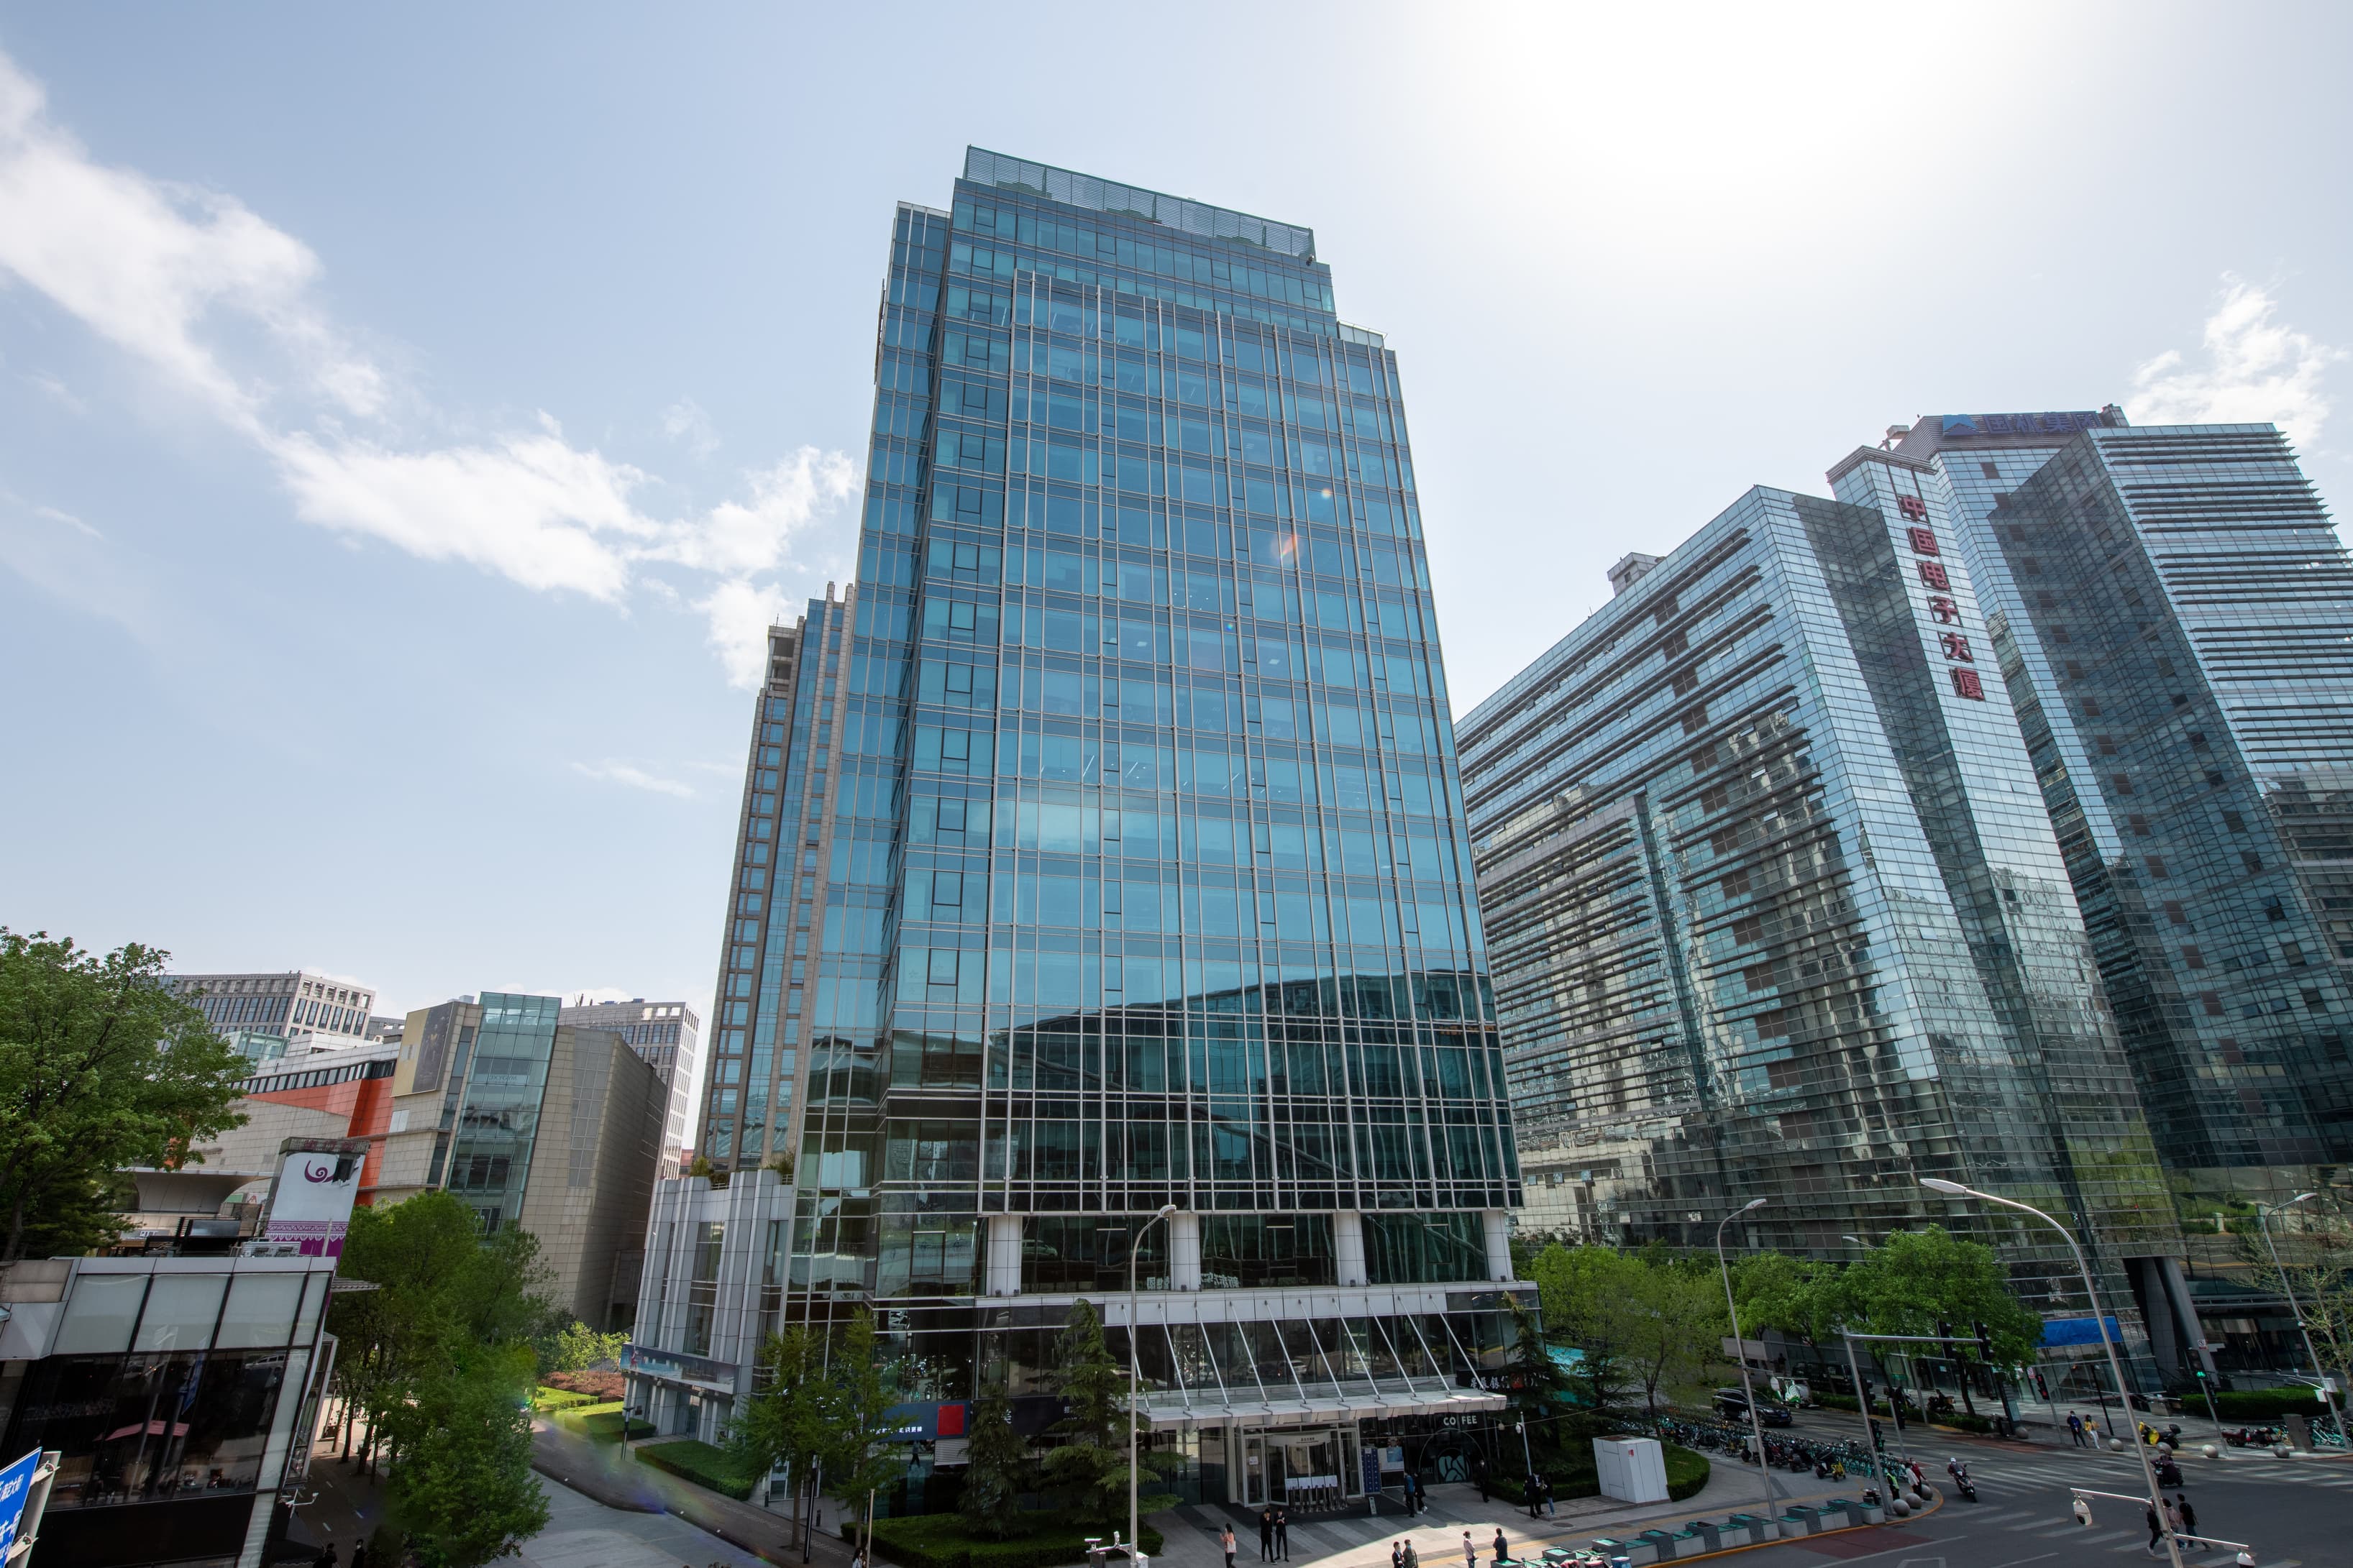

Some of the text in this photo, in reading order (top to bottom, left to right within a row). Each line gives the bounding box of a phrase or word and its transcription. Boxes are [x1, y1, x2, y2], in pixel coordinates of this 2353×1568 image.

[1983, 411, 2101, 435] 国机集团
[1901, 495, 1985, 702] 中国电子大厦
